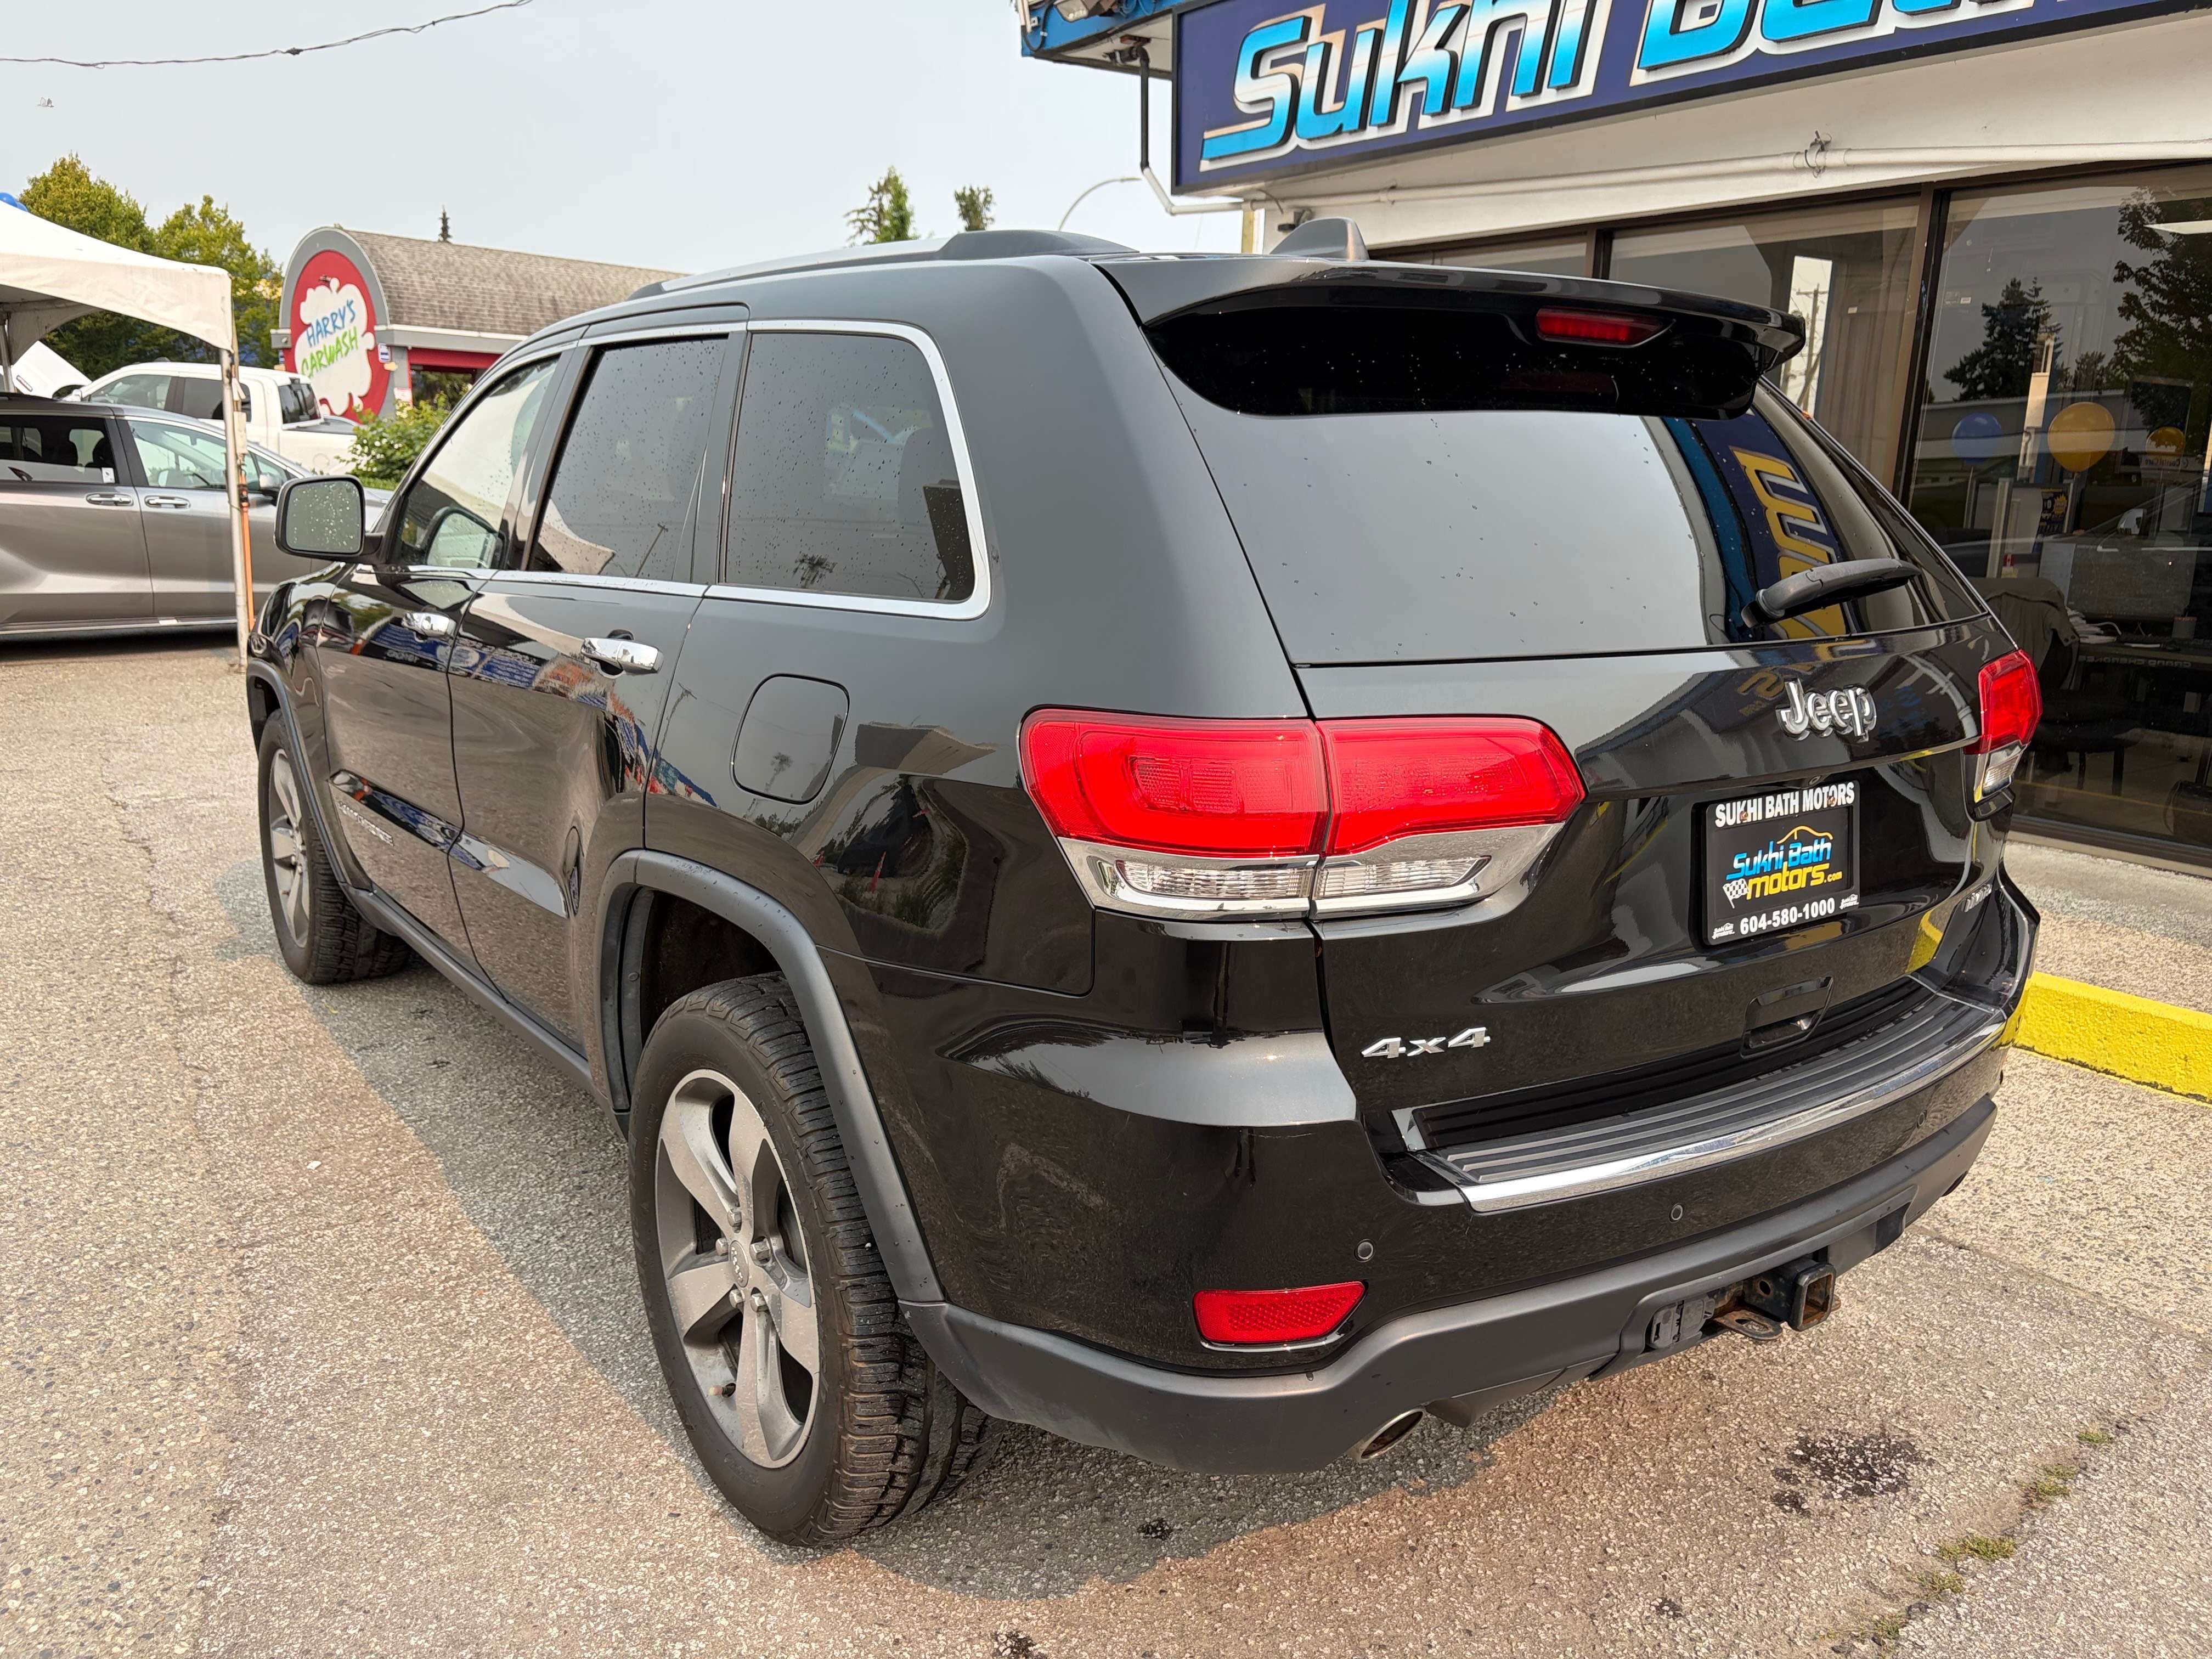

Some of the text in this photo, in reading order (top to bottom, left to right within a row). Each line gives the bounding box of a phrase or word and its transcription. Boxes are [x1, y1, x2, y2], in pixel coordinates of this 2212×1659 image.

[301, 326, 359, 377] CARWASH
[1776, 678, 1877, 742] Jeep
[1715, 782, 1855, 828] SUKHI BATH MOTORS
[1726, 838, 1833, 881] Sukhi Bath
[1740, 898, 1835, 935] 604-580-1000
[1361, 1026, 1491, 1059] 4x4
